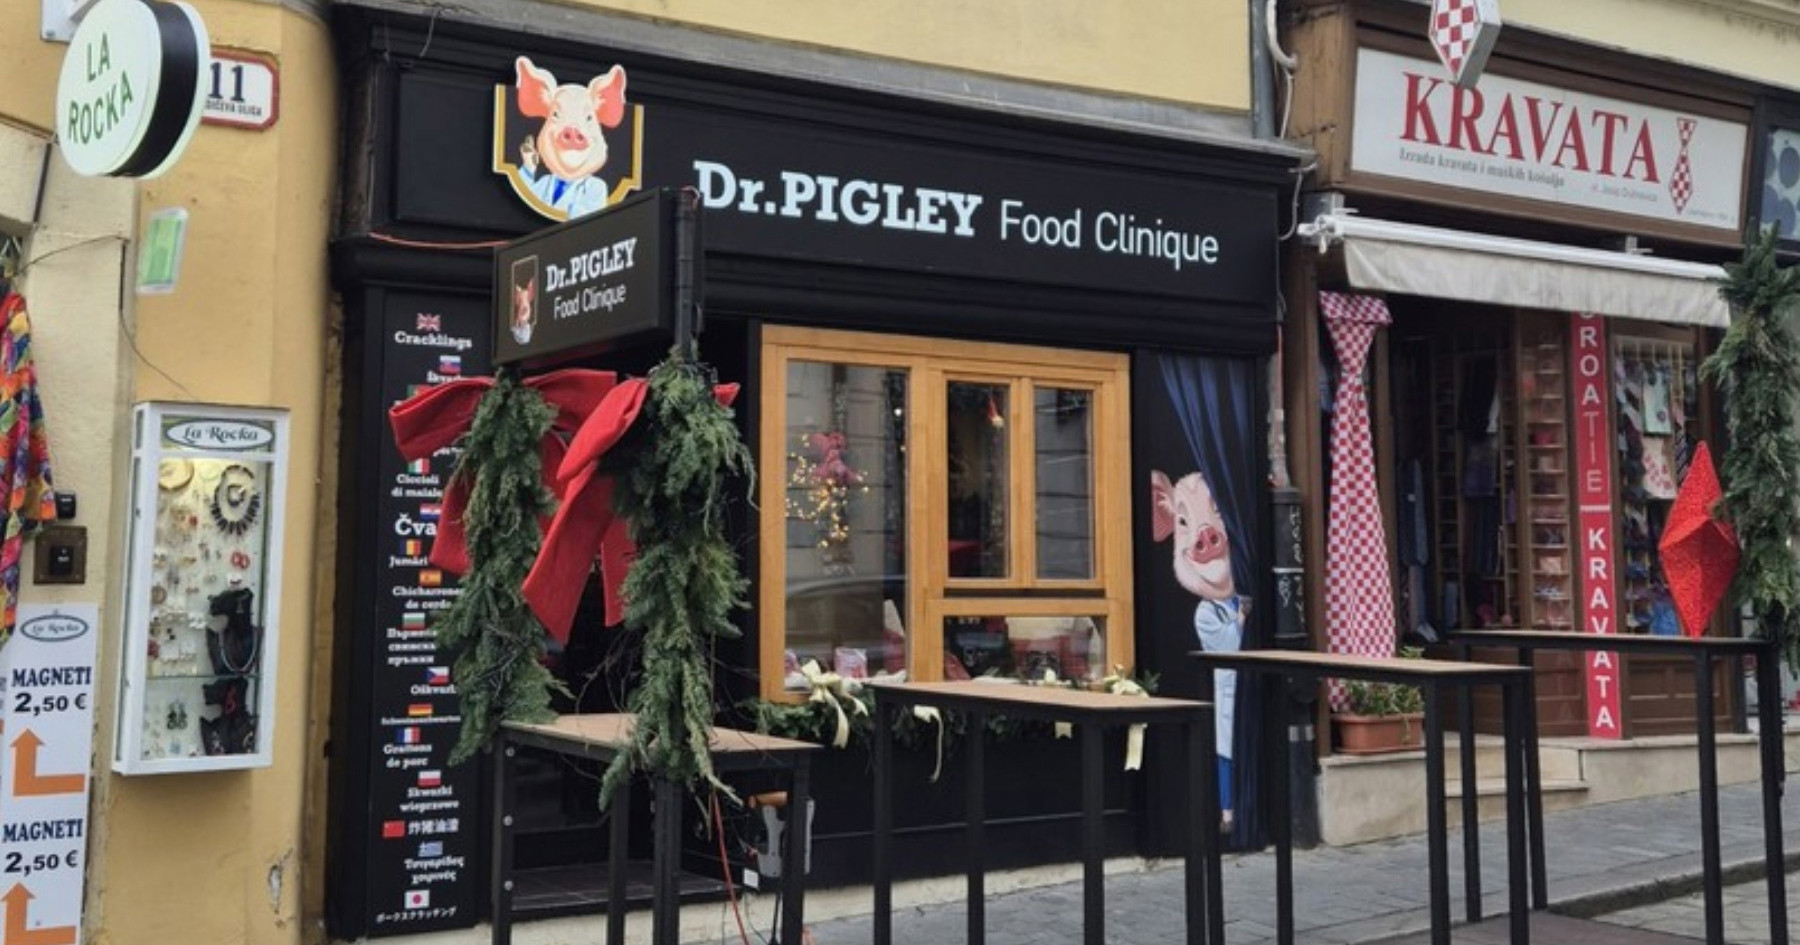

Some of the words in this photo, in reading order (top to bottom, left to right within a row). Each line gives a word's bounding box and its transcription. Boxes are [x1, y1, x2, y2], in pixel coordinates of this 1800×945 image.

[86, 32, 111, 82] LA
[208, 62, 245, 103] 11
[68, 70, 133, 145] ROCKA
[1399, 72, 1660, 184] KRAVATA
[1438, 154, 1477, 173] kravata
[694, 160, 983, 236] Dr.PIGLEY
[1000, 200, 1081, 249] Food
[1095, 212, 1219, 270] Clinique
[545, 237, 638, 292] Dr.PIGLEY
[554, 290, 579, 320] Food
[583, 283, 627, 312] Clinique
[394, 330, 472, 351] Cracklings
[183, 427, 202, 444] La
[209, 426, 258, 443] Rocka
[391, 487, 404, 497] di
[394, 512, 437, 536] Čva
[1588, 527, 1615, 729] KRAVATA
[12, 666, 91, 688] MAGNETI
[14, 692, 69, 717] 2,50
[75, 693, 87, 710] €
[386, 757, 400, 768] de
[402, 758, 428, 770] porc
[2, 818, 83, 844] MAGNETI
[4, 851, 60, 877] 2,50
[65, 850, 79, 869] €
